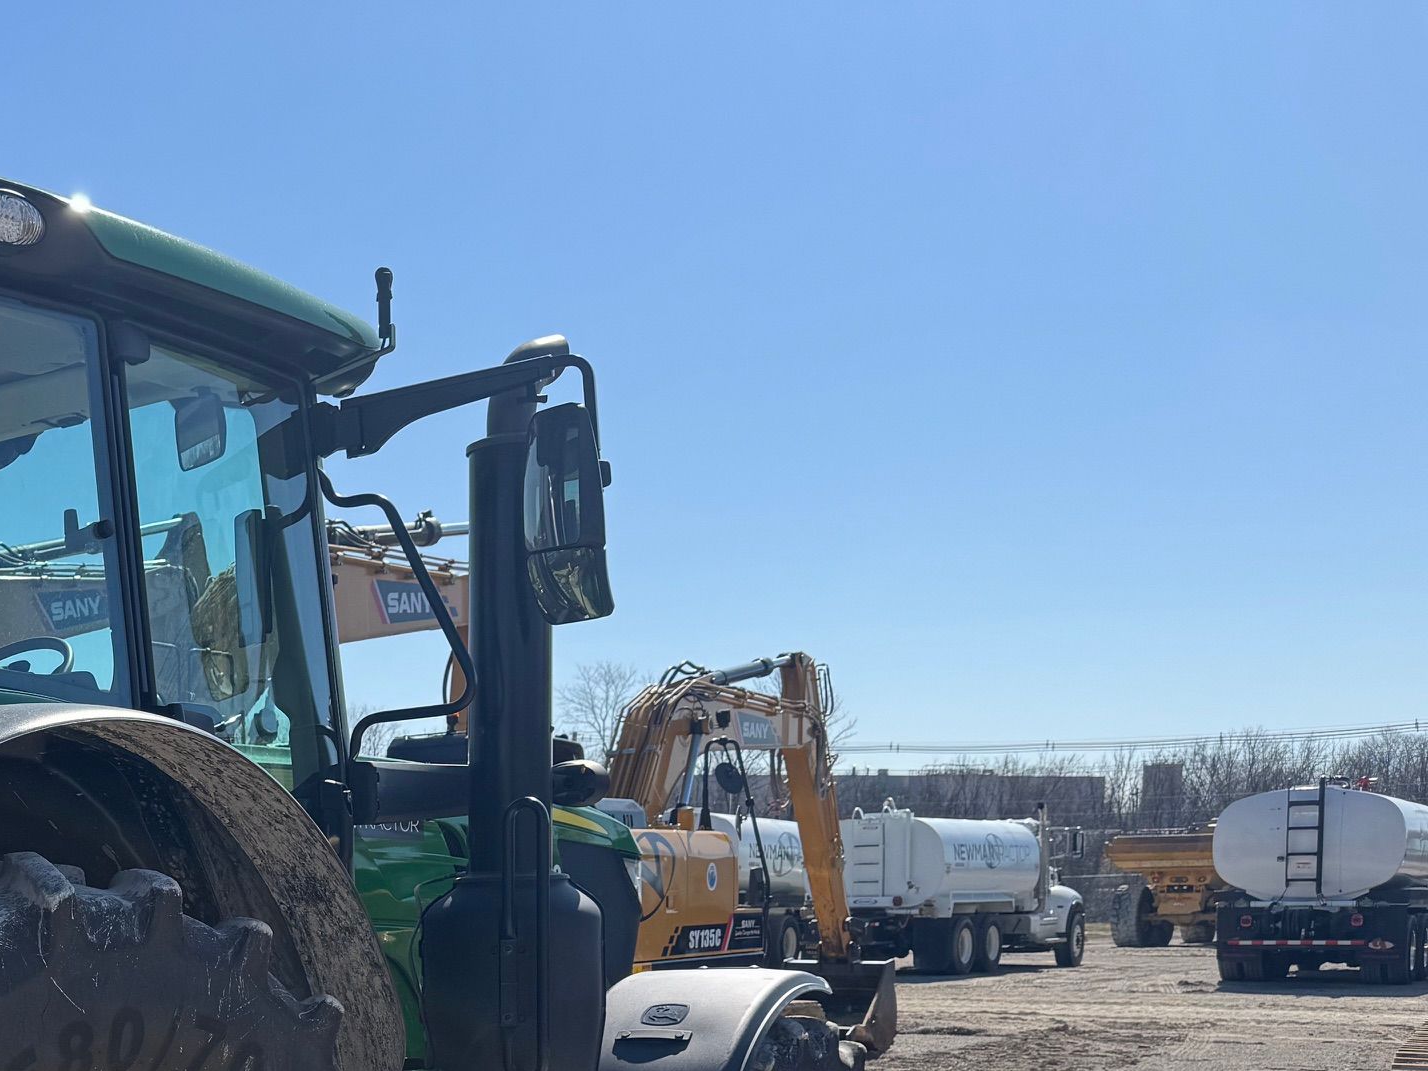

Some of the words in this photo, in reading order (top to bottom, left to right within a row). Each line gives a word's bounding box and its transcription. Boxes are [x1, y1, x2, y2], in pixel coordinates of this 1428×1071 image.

[50, 596, 101, 621] SANY
[742, 721, 770, 739] SANY
[688, 928, 722, 949] SY135C
